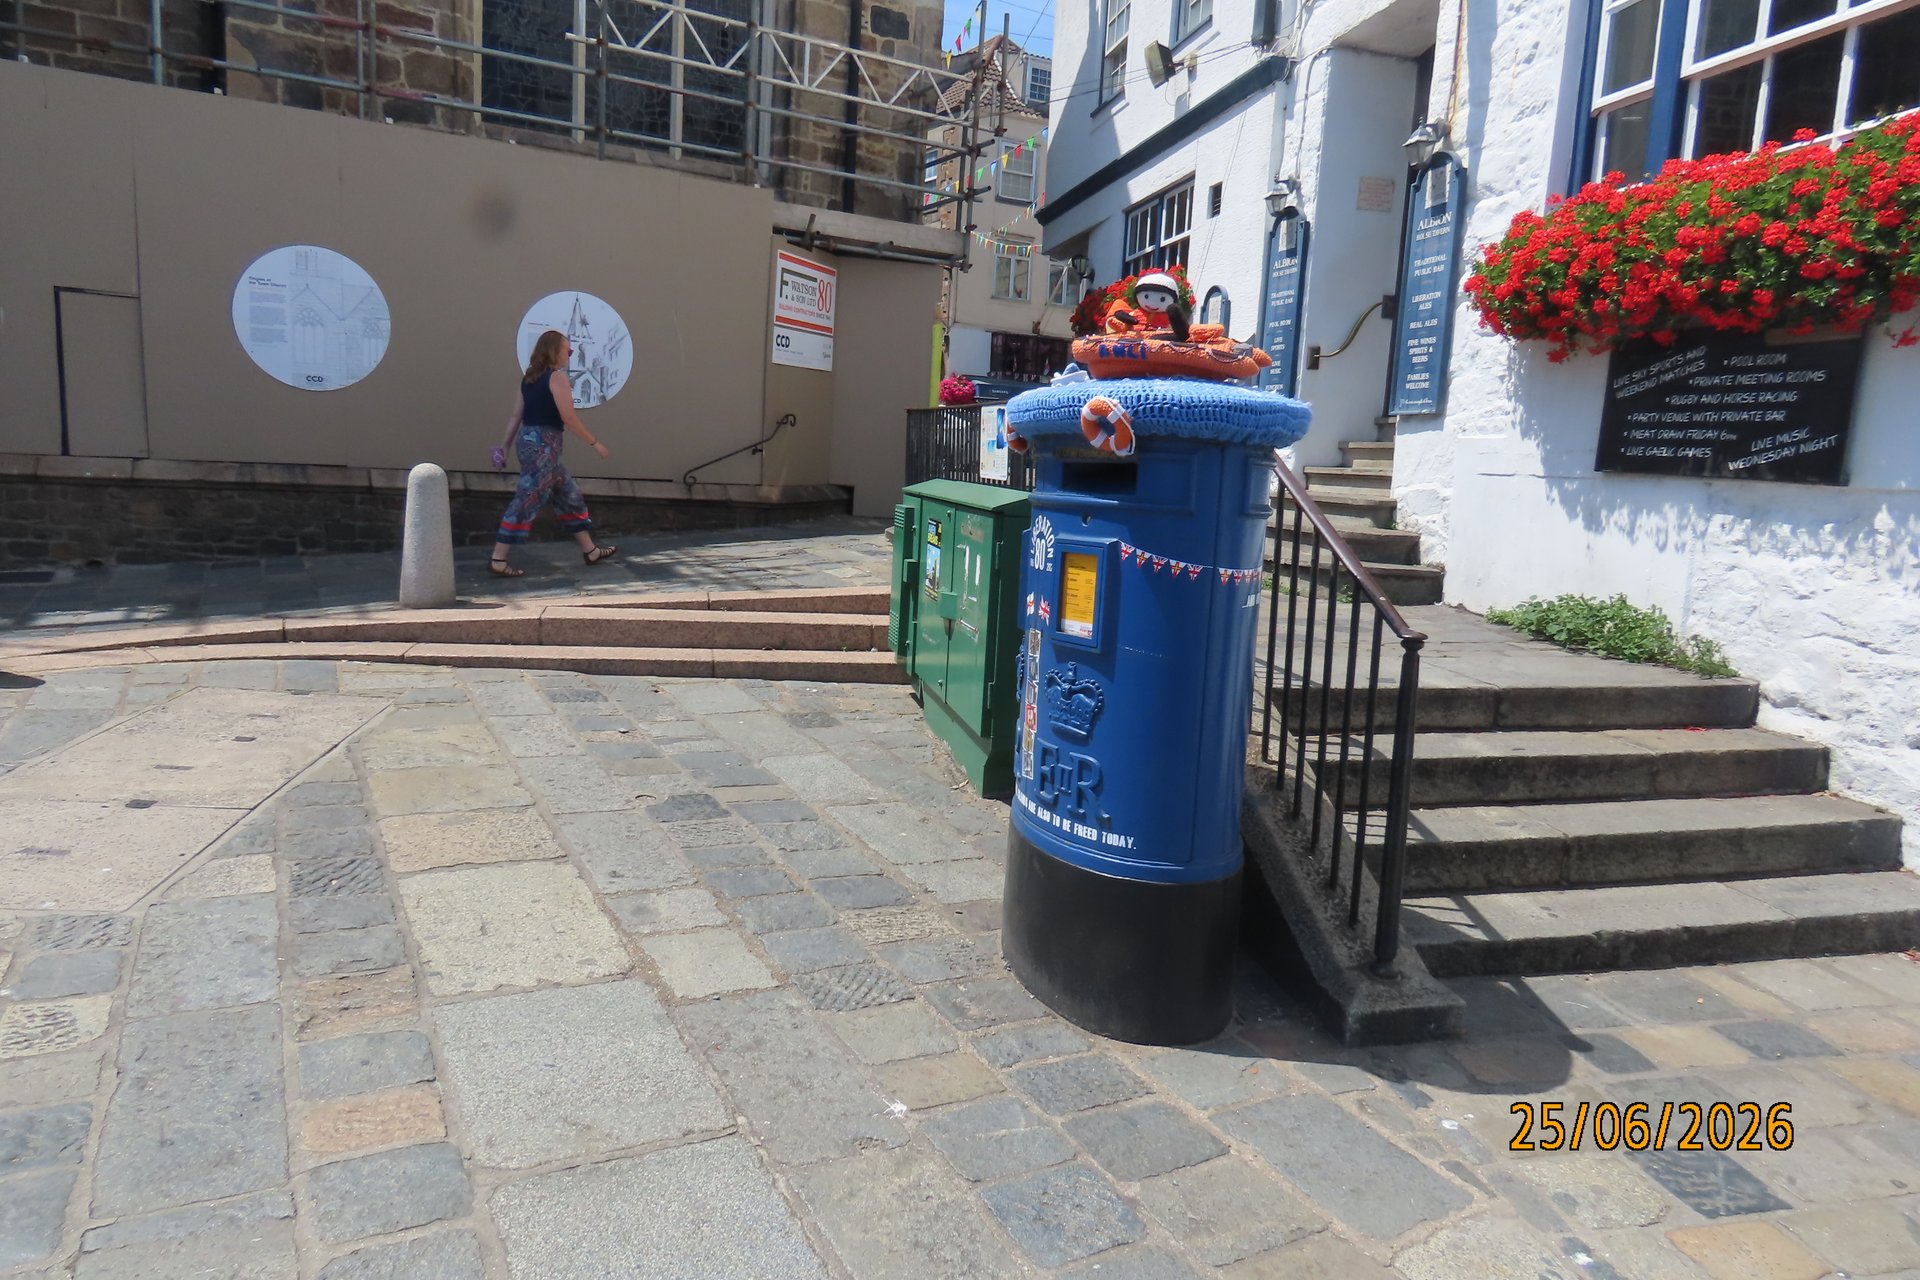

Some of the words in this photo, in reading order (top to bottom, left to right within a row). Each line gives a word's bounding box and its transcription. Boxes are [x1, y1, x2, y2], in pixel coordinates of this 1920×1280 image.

[1417, 211, 1452, 231] ALBION
[1273, 256, 1298, 270] ALBION
[1414, 254, 1447, 267] TRADITIONAL
[1414, 268, 1432, 277] PUBLIC
[1433, 264, 1445, 273] BAR
[791, 280, 818, 297] WATSON
[791, 294, 795, 302] &
[796, 296, 806, 305] SON
[806, 298, 817, 307] LTD
[817, 279, 832, 313] 80
[1411, 291, 1441, 303] LIBERATION
[1418, 302, 1432, 311] ALES
[1409, 321, 1423, 330] REAL
[1424, 318, 1438, 327] ALES
[776, 334, 790, 349] CCD
[1407, 339, 1419, 347] FINE
[1420, 336, 1437, 345] WINES
[1408, 346, 1428, 355] SPIRITS
[1412, 355, 1429, 364] BEERS
[1730, 355, 1755, 367] POOL
[1756, 353, 1788, 366] ROOM
[1613, 374, 1631, 389] LIVE
[1632, 368, 1648, 378] SKY
[1648, 353, 1685, 376] SPORTS
[1686, 345, 1707, 360] AND
[306, 375, 324, 383] CCD
[1407, 372, 1430, 381] FAMILIES
[1616, 377, 1658, 399] WEEKEND
[1659, 359, 1706, 384] MATCHES
[1693, 374, 1734, 387] PRIVATE
[1735, 372, 1784, 385] MEETING
[1786, 369, 1826, 383] ROOMS
[1405, 381, 1430, 390] WELCOME
[1670, 394, 1698, 405] RUGBY
[1700, 393, 1721, 404] AND
[1722, 391, 1758, 404] HORSE
[1758, 390, 1798, 402] RACING
[1631, 412, 1659, 422] PARTY
[1661, 411, 1691, 422] VENUE
[1692, 411, 1719, 422] WITH
[1720, 410, 1763, 421] PRIVATE
[1765, 410, 1786, 422] BAR
[1630, 429, 1658, 440] MEAT
[1657, 429, 1685, 440] DRAW
[1686, 429, 1719, 440] FRIDAY
[1751, 436, 1773, 452] LIVE
[1775, 427, 1810, 446] MUSIC
[1626, 446, 1645, 456] LIVE
[1645, 446, 1676, 457] GAELIC
[1677, 447, 1712, 458] GAMES
[1727, 445, 1797, 471] WEDNESDAY
[1800, 434, 1839, 454] NIGHT
[1035, 538, 1046, 570] 80
[1037, 806, 1051, 823] ALSO
[1052, 813, 1061, 828] TO
[1062, 818, 1071, 832] BE
[1073, 822, 1098, 841] FREED
[1102, 831, 1137, 850] TODAY.
